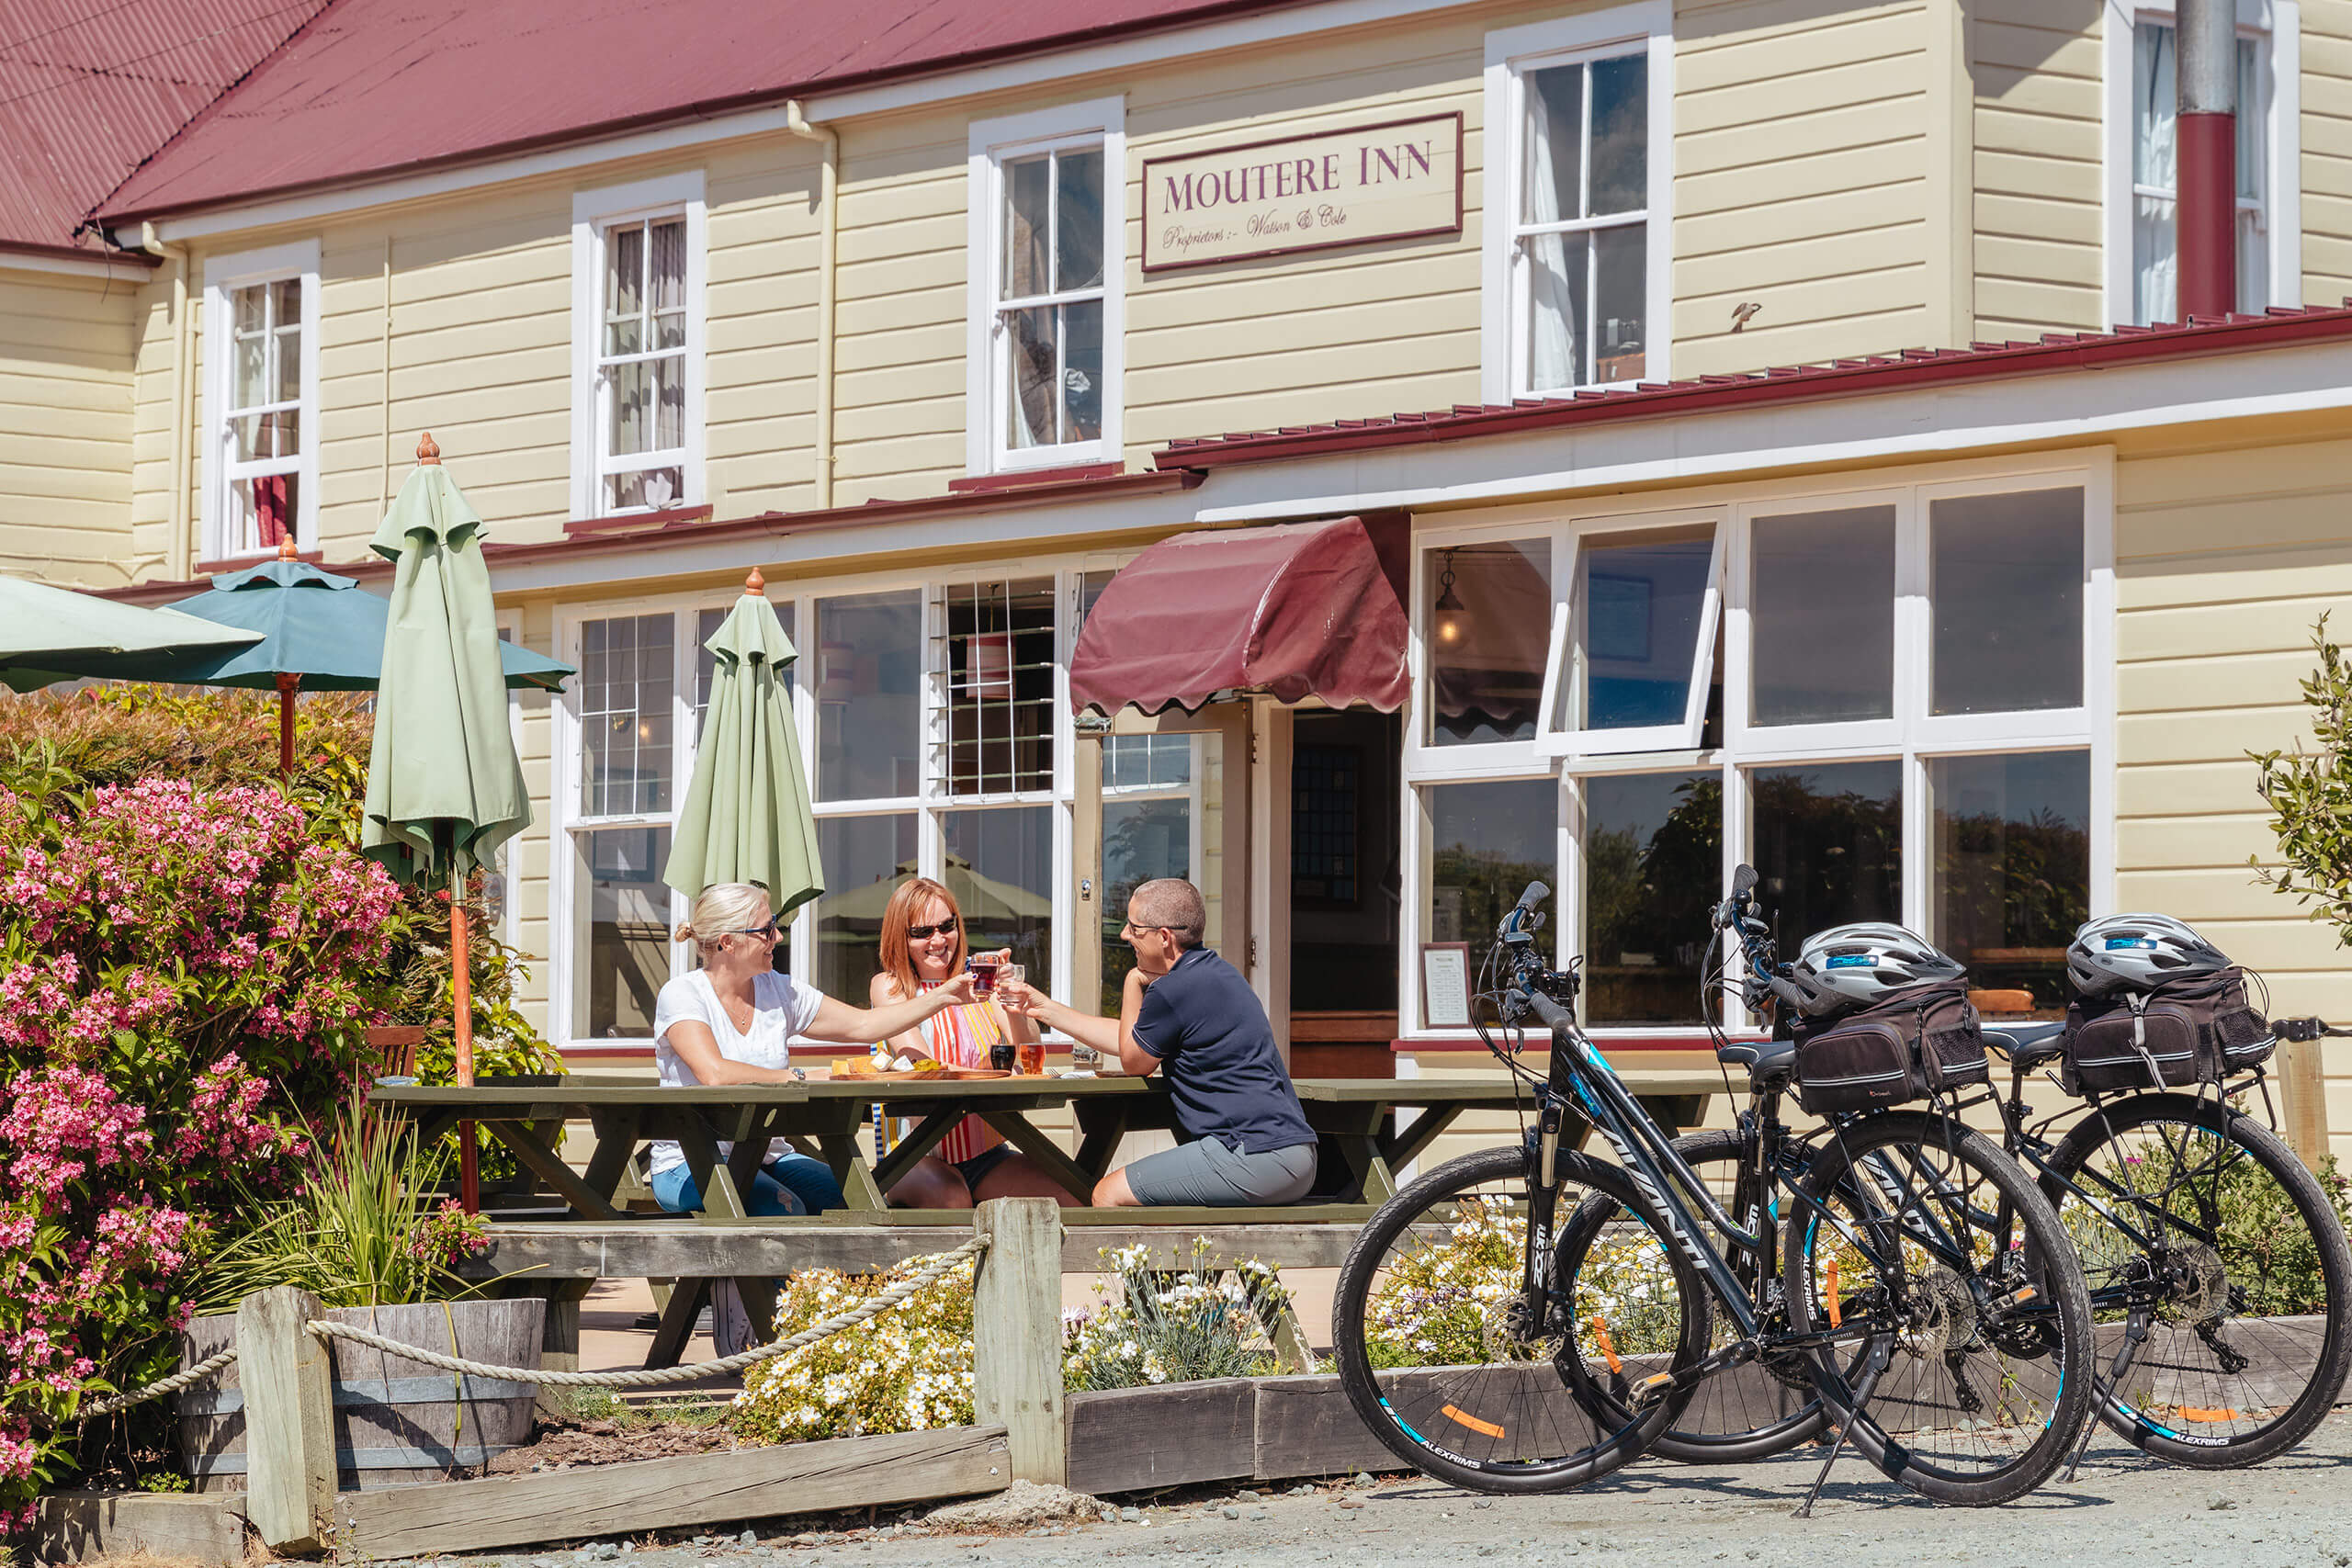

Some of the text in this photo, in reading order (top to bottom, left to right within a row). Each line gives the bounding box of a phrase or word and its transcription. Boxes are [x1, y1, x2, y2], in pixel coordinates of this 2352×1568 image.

[1163, 140, 1433, 213] MOUTERE INN
[1247, 209, 1291, 237] Watson
[1317, 204, 1347, 228] Cole
[1595, 1124, 1710, 1269] AVANTI
[1803, 1253, 1817, 1321] ALEXRIMS
[1420, 1439, 1481, 1469] ALEXRIMS
[2172, 1434, 2230, 1446] ALEXRIMS
